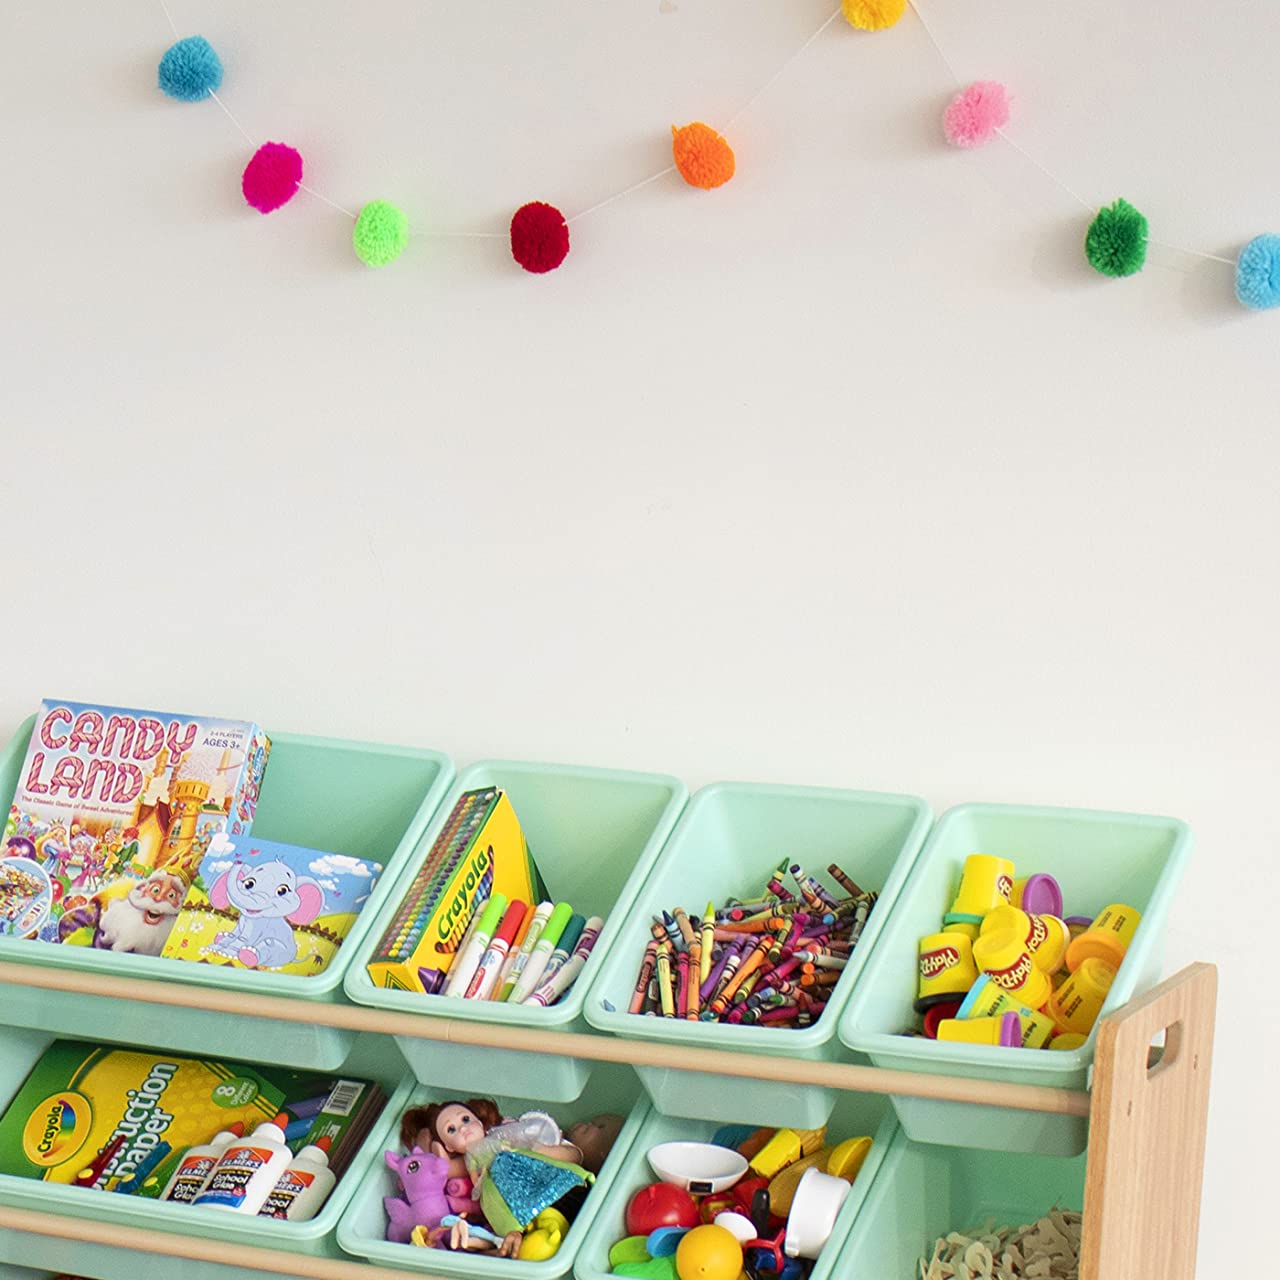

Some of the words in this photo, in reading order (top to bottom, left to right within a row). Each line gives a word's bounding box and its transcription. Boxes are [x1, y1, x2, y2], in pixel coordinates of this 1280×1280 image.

[40, 707, 198, 764] CANDY
[202, 738, 228, 748] AGES
[25, 752, 144, 804] LAND
[438, 850, 488, 940] Crayola
[216, 1085, 235, 1096] 8
[38, 1105, 62, 1153] Crayola
[212, 1181, 234, 1190] Glue
[213, 1174, 248, 1184] School
